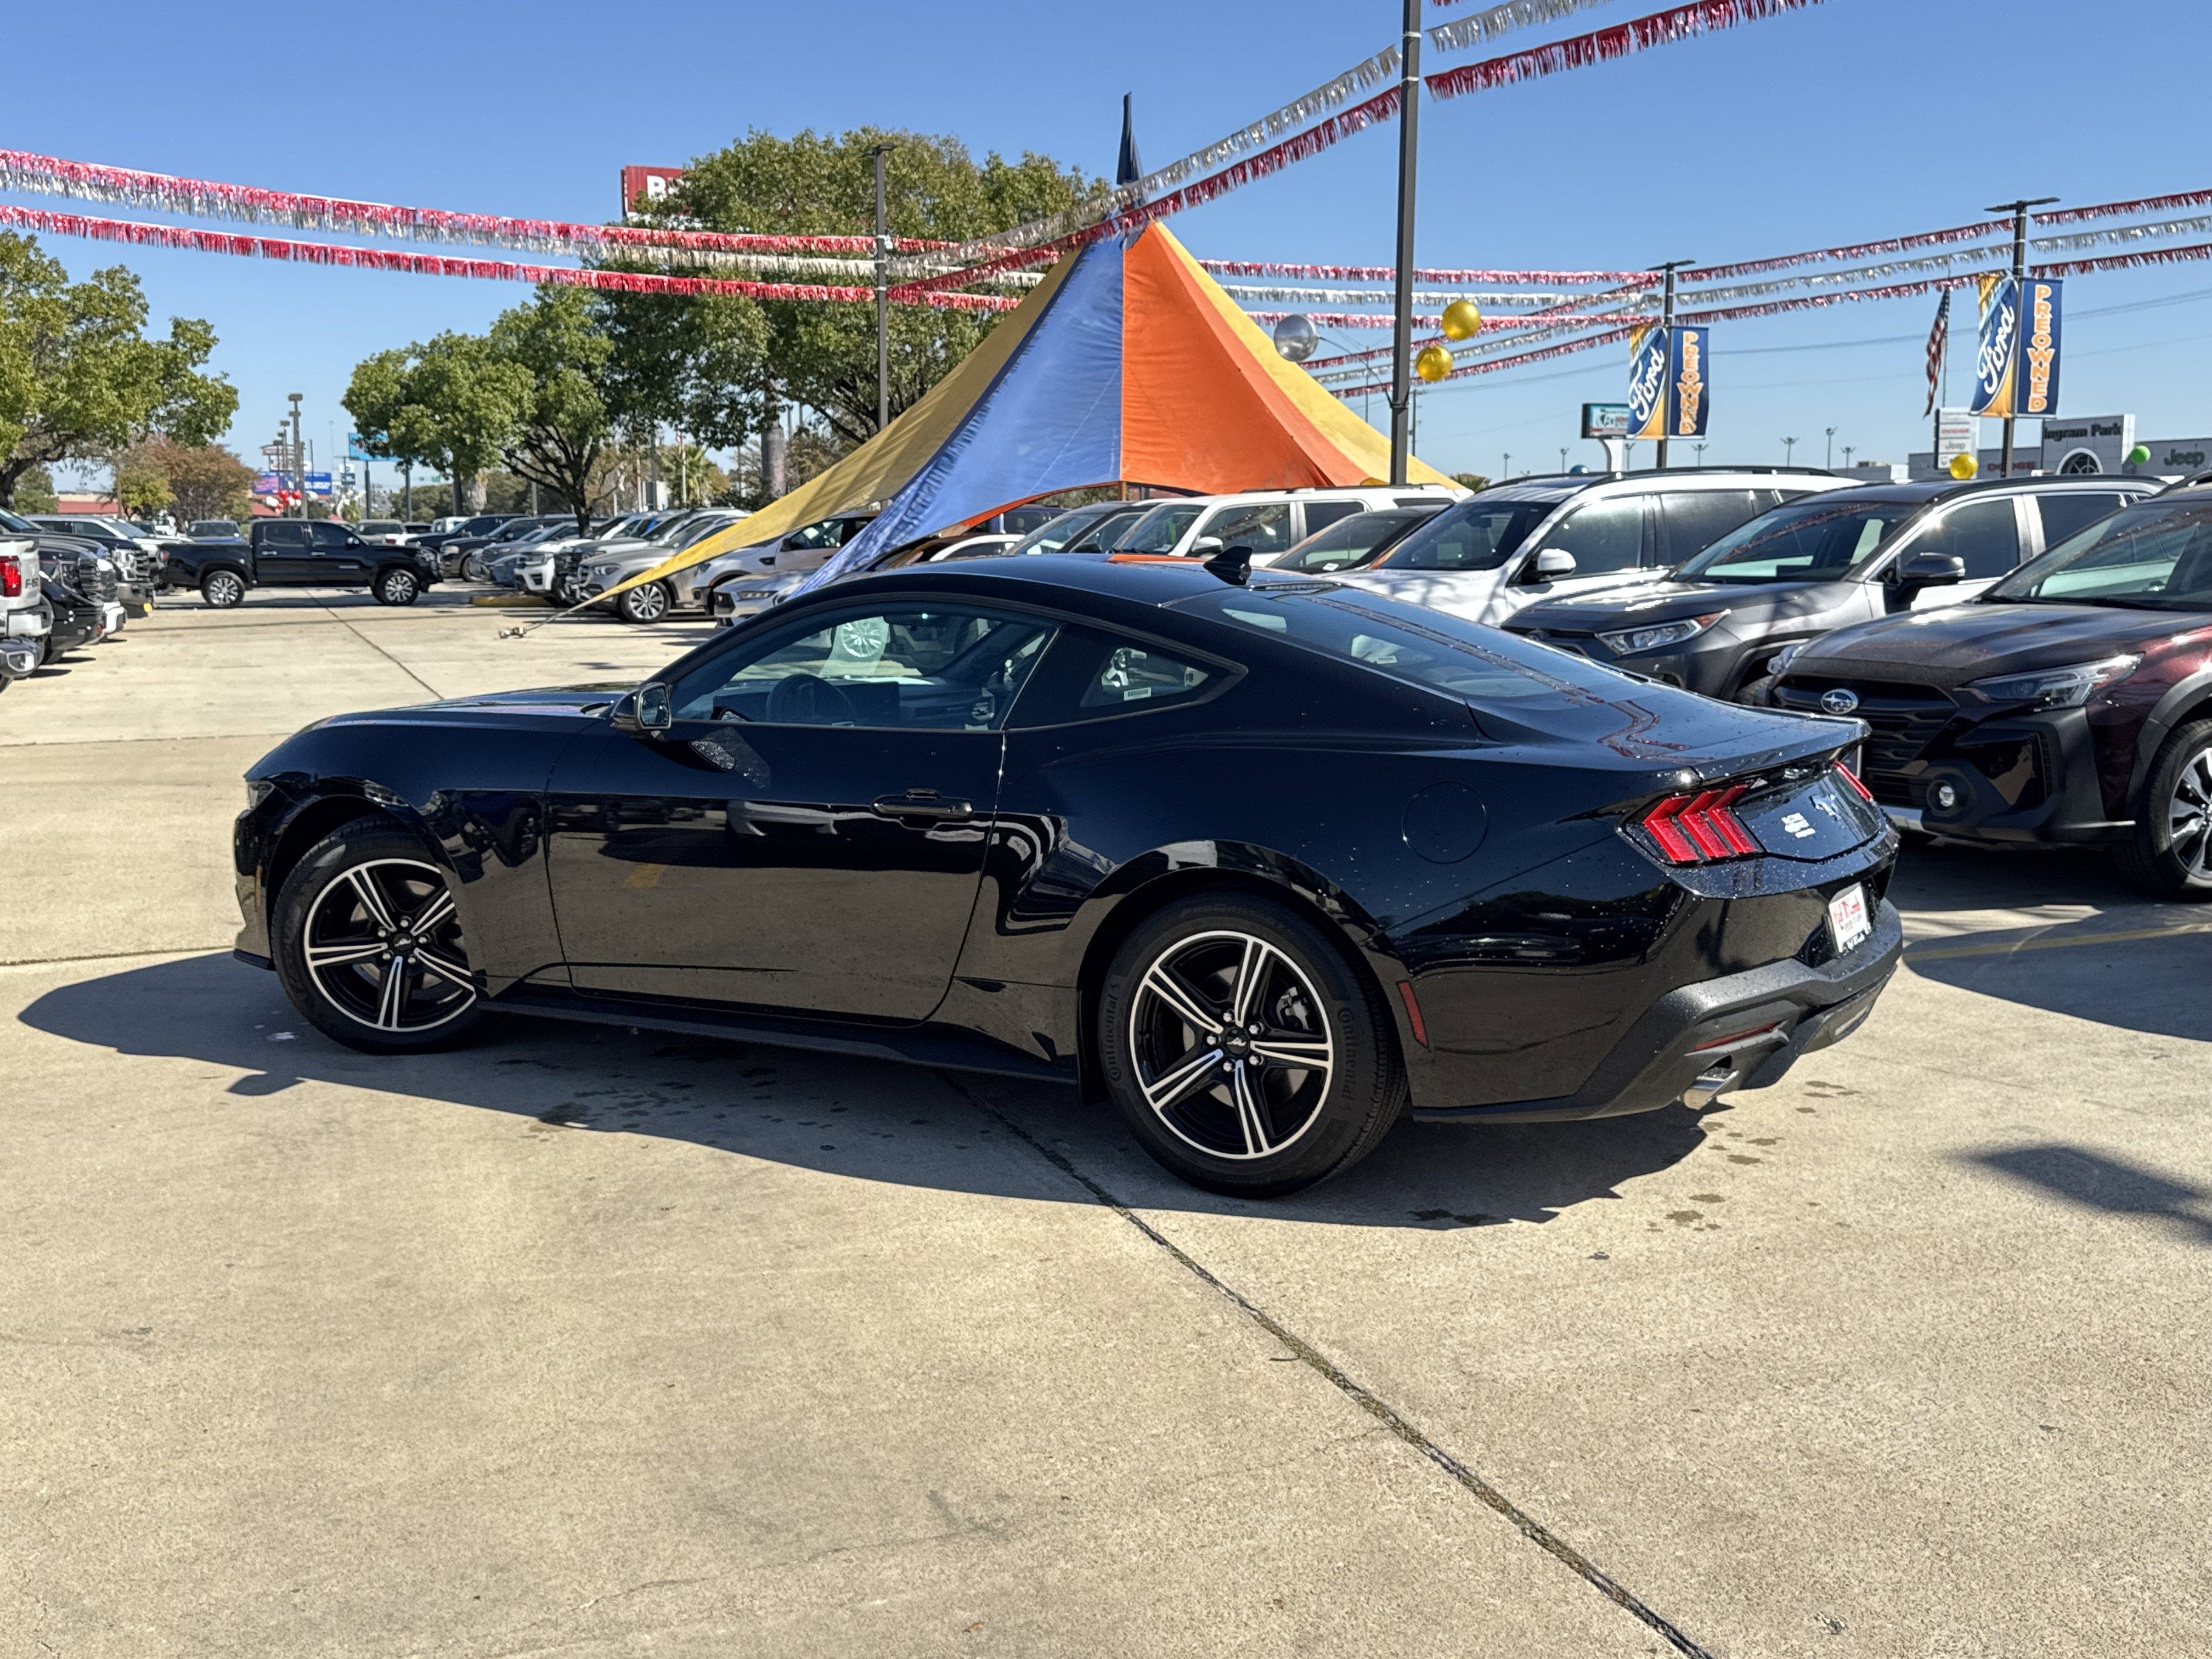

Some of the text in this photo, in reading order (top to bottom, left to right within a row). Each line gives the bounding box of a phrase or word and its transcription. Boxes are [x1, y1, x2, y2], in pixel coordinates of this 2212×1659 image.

[1628, 345, 1664, 421] Ford
[1676, 331, 1704, 435] PREOWNED
[1977, 302, 2015, 394] Ford
[2027, 284, 2055, 413] PREOWNED
[2044, 428, 2088, 442] Ingram
[2164, 448, 2205, 468] Jeep
